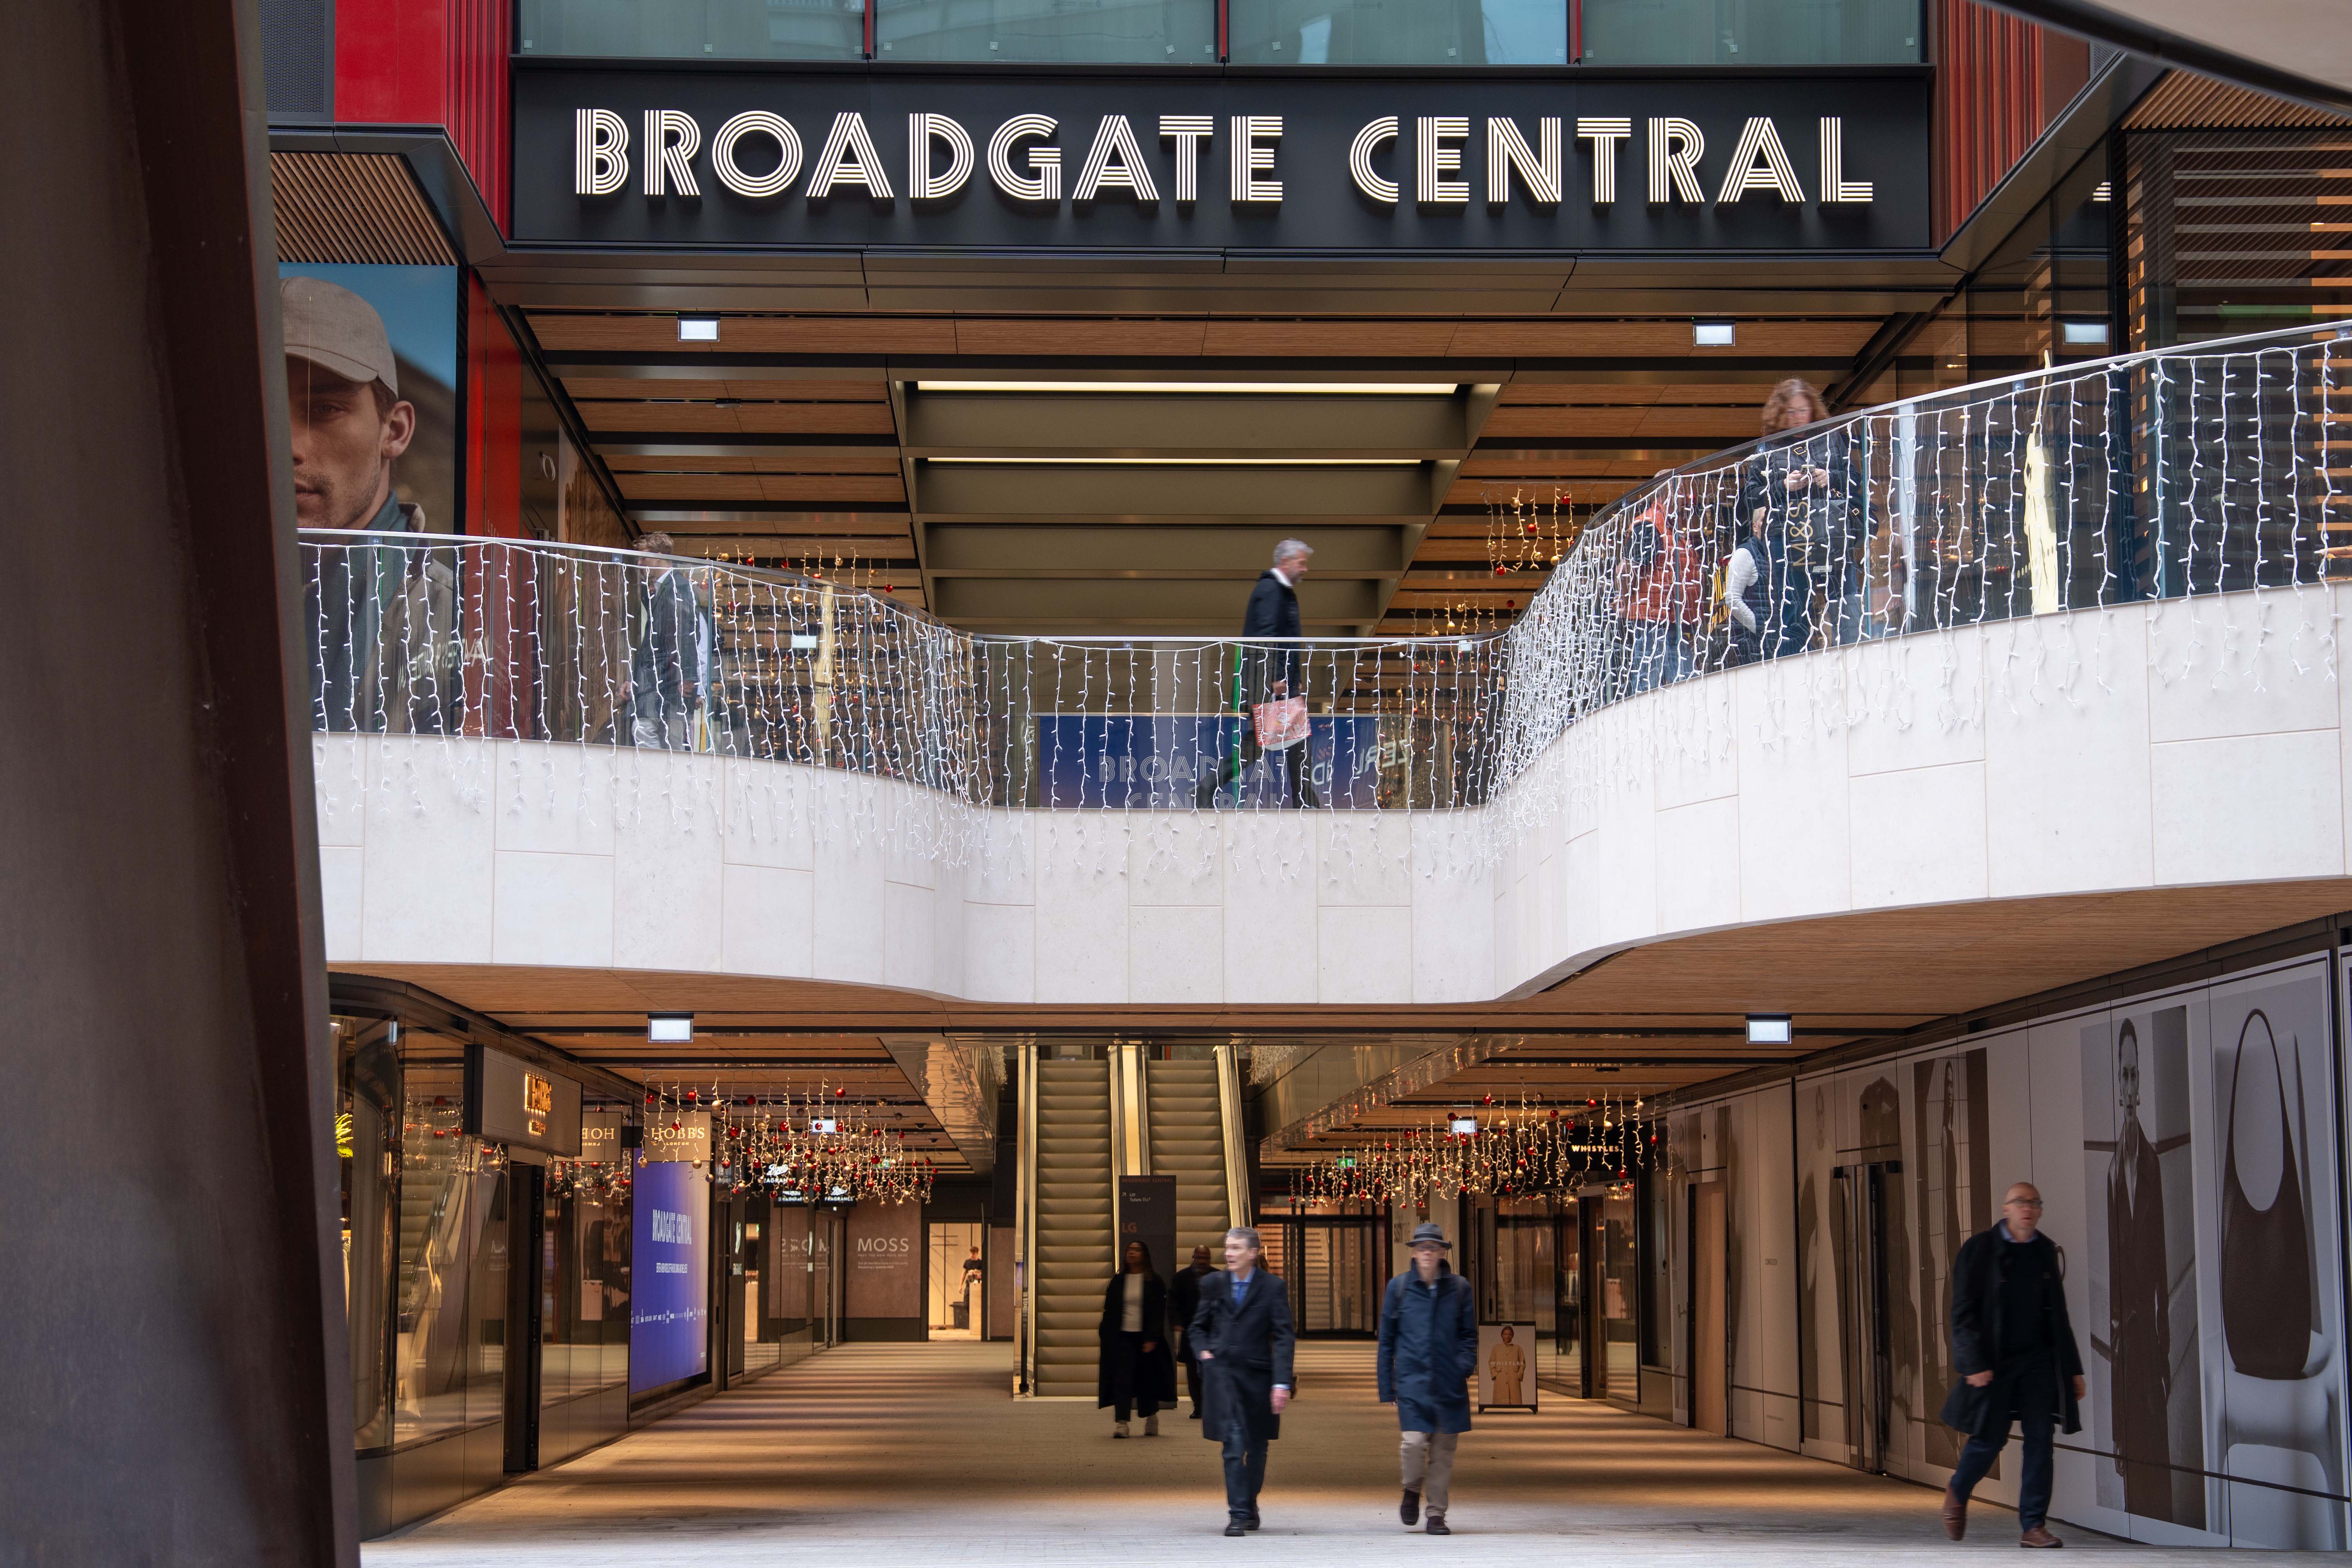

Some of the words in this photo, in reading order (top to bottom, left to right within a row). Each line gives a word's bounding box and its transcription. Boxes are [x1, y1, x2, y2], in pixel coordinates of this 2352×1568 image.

[575, 108, 1284, 200] BROADGATE
[1349, 116, 1873, 204] CENTRAL
[1789, 501, 1816, 566] M&S
[651, 1127, 705, 1139] HOBBS
[652, 1209, 675, 1243] BROADGATE
[676, 1213, 692, 1245] CENTRAL
[1122, 1222, 1137, 1233] LG
[858, 1238, 909, 1252] MOSS
